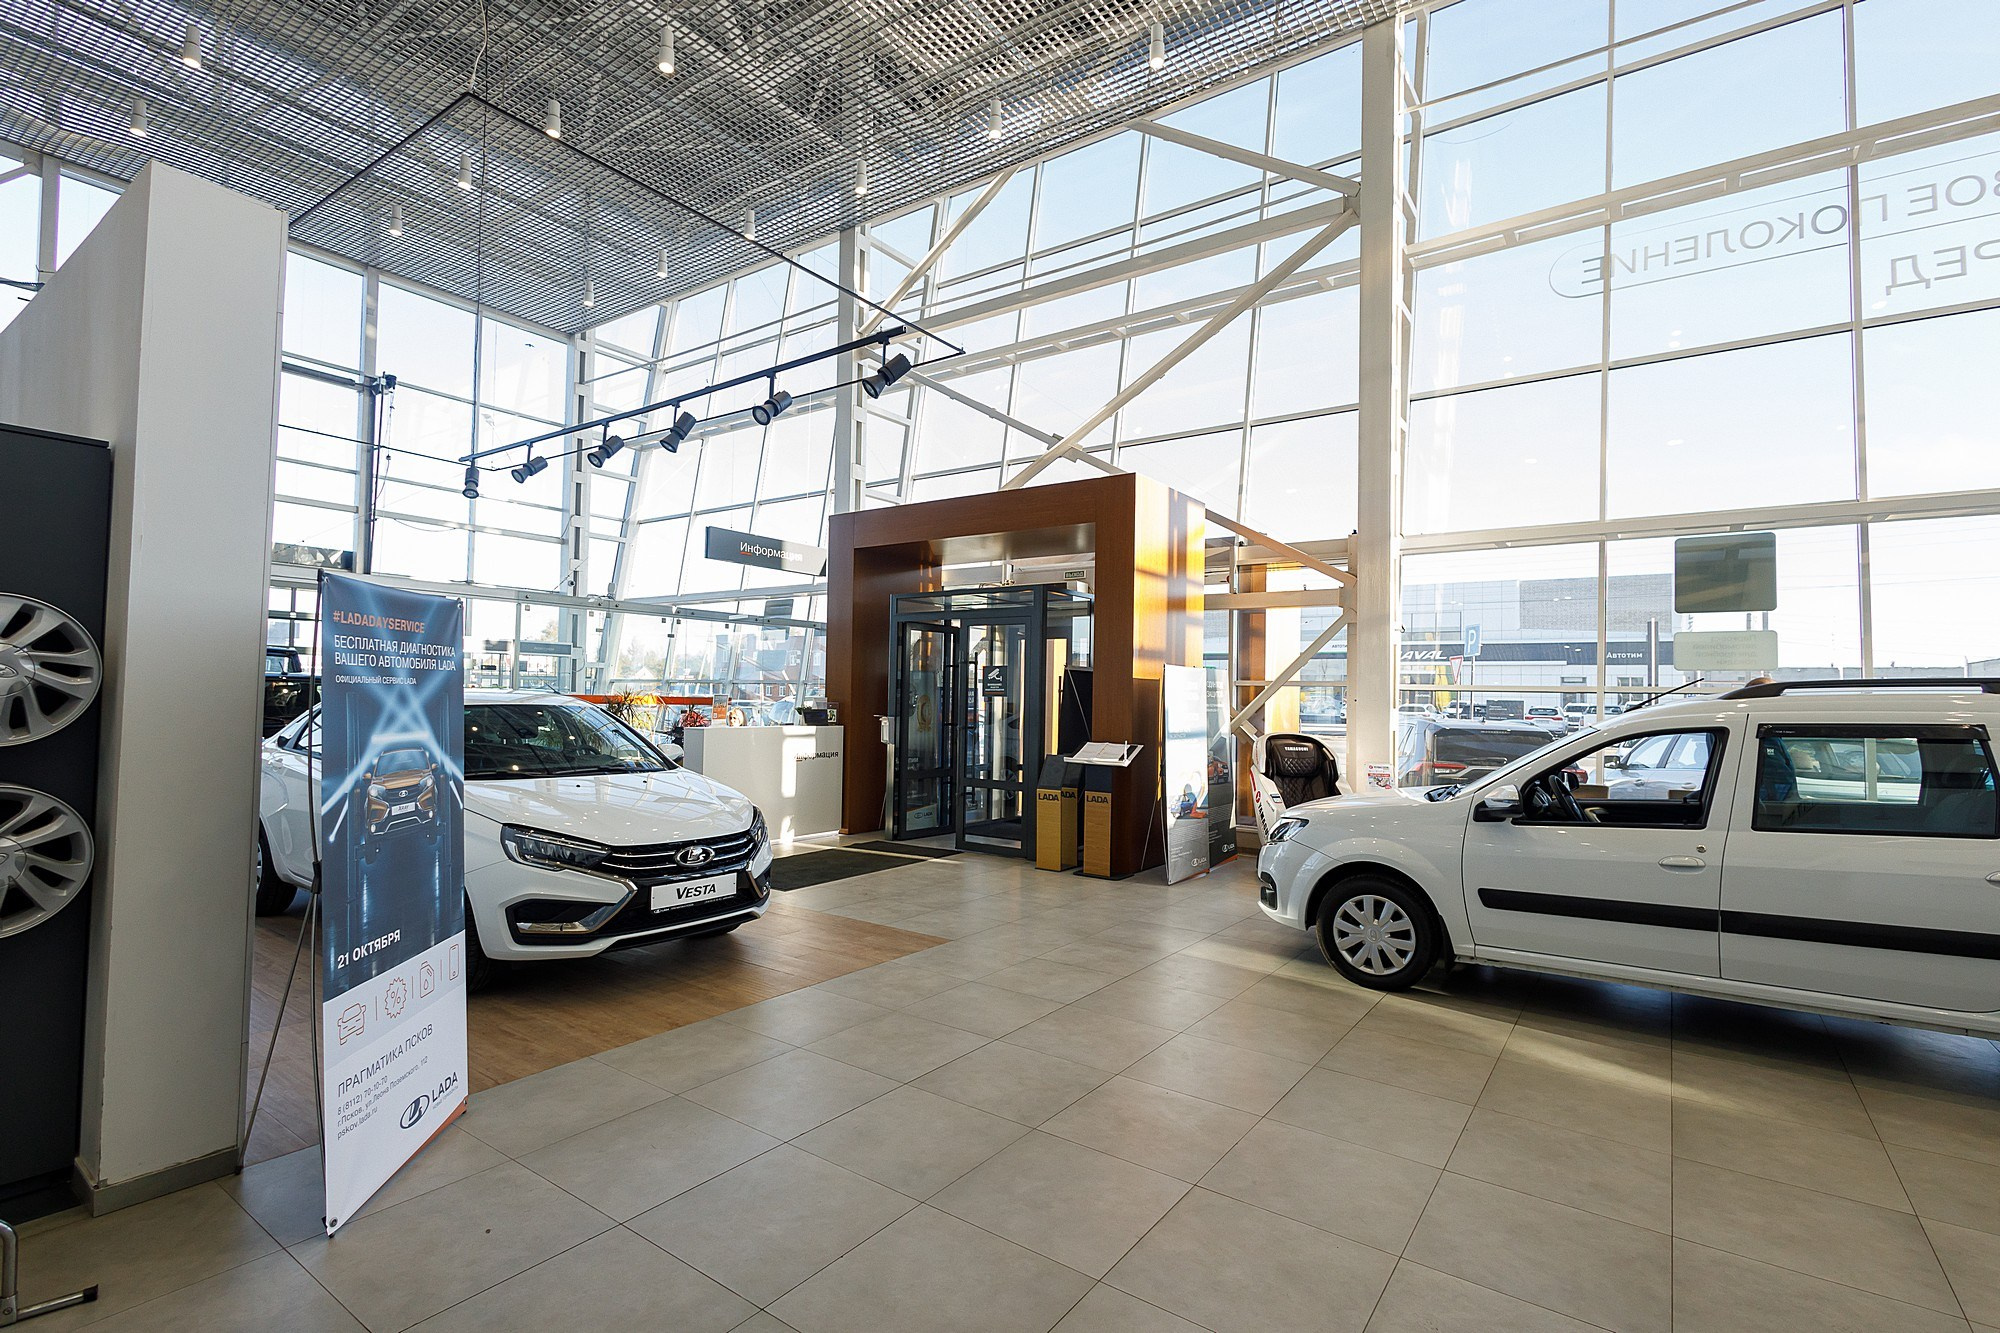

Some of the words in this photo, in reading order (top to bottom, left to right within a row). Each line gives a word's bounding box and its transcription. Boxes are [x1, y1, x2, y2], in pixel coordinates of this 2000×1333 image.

[740, 541, 803, 562] Информация
[333, 610, 425, 633] #LADADAYSERVICE
[334, 634, 398, 653] БЕСПЛАТНАЯ
[400, 641, 456, 658] ДИАГНОСТИКА
[1401, 650, 1448, 660] AVAL
[1606, 651, 1643, 659] Автотим
[335, 652, 376, 667] ВАШЕГО
[378, 655, 437, 670] АВТОМОБИЛЯ
[438, 659, 456, 671] LADA
[335, 674, 381, 685] ОФИЦИАЛЬНЫЙ
[382, 676, 404, 685] СЕРВИС
[404, 677, 417, 685] LADA
[1038, 792, 1059, 802] LADA
[1061, 790, 1076, 799] ADA
[1086, 794, 1109, 804] LADA
[676, 883, 716, 900] VESTA
[337, 952, 349, 969] 21
[352, 929, 400, 961] ОКТЯБРЯ
[338, 1044, 403, 1097] ПРАГМАТИКА
[405, 1023, 433, 1052] ПСКОВ
[337, 1106, 342, 1116] 8
[342, 1092, 363, 1113] (8112)
[364, 1075, 388, 1098] 70-10-70
[432, 1071, 458, 1103] LADA
[337, 1107, 378, 1140] pskov.lada.ru
